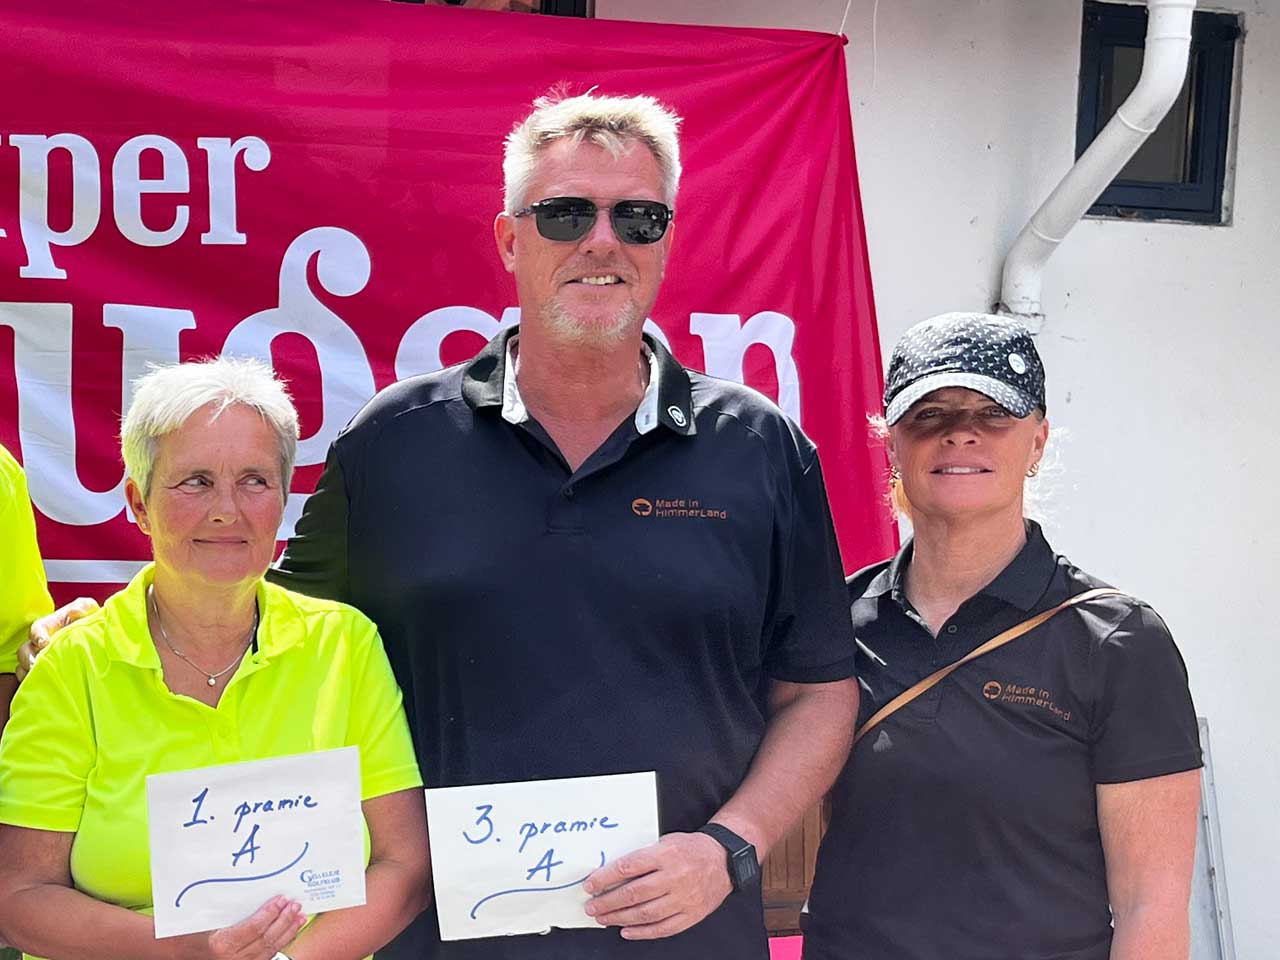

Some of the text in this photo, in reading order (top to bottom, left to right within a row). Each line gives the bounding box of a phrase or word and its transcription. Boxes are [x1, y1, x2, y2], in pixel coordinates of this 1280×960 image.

[655, 499, 686, 508] Made
[1006, 684, 1036, 695] Made
[183, 787, 215, 827] 1.
[462, 804, 501, 844] 3.
[232, 824, 261, 867] A
[526, 848, 563, 882] A
